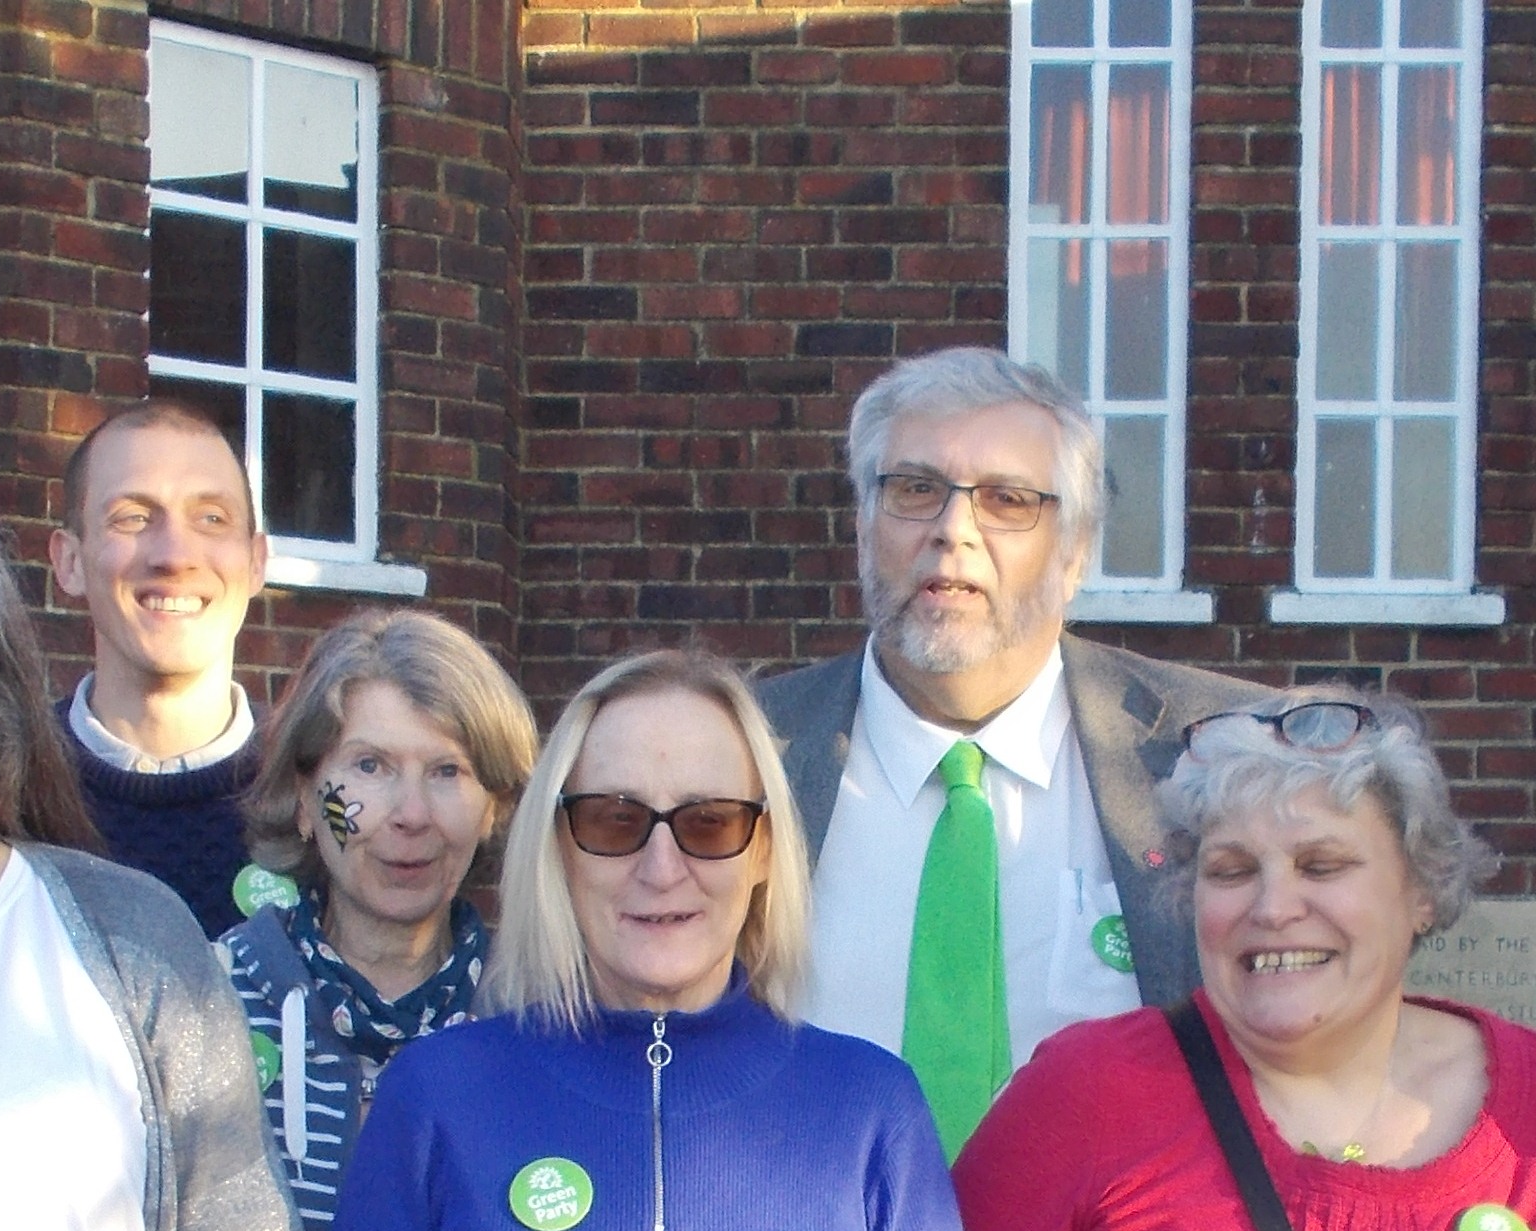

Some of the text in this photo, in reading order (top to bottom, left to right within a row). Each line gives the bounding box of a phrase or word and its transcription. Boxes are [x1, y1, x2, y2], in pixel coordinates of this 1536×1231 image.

[1105, 933, 1130, 949] Gre
[1459, 936, 1480, 951] BY
[1496, 937, 1530, 952] THE
[528, 1186, 577, 1209] Green
[535, 1200, 578, 1224] Party
